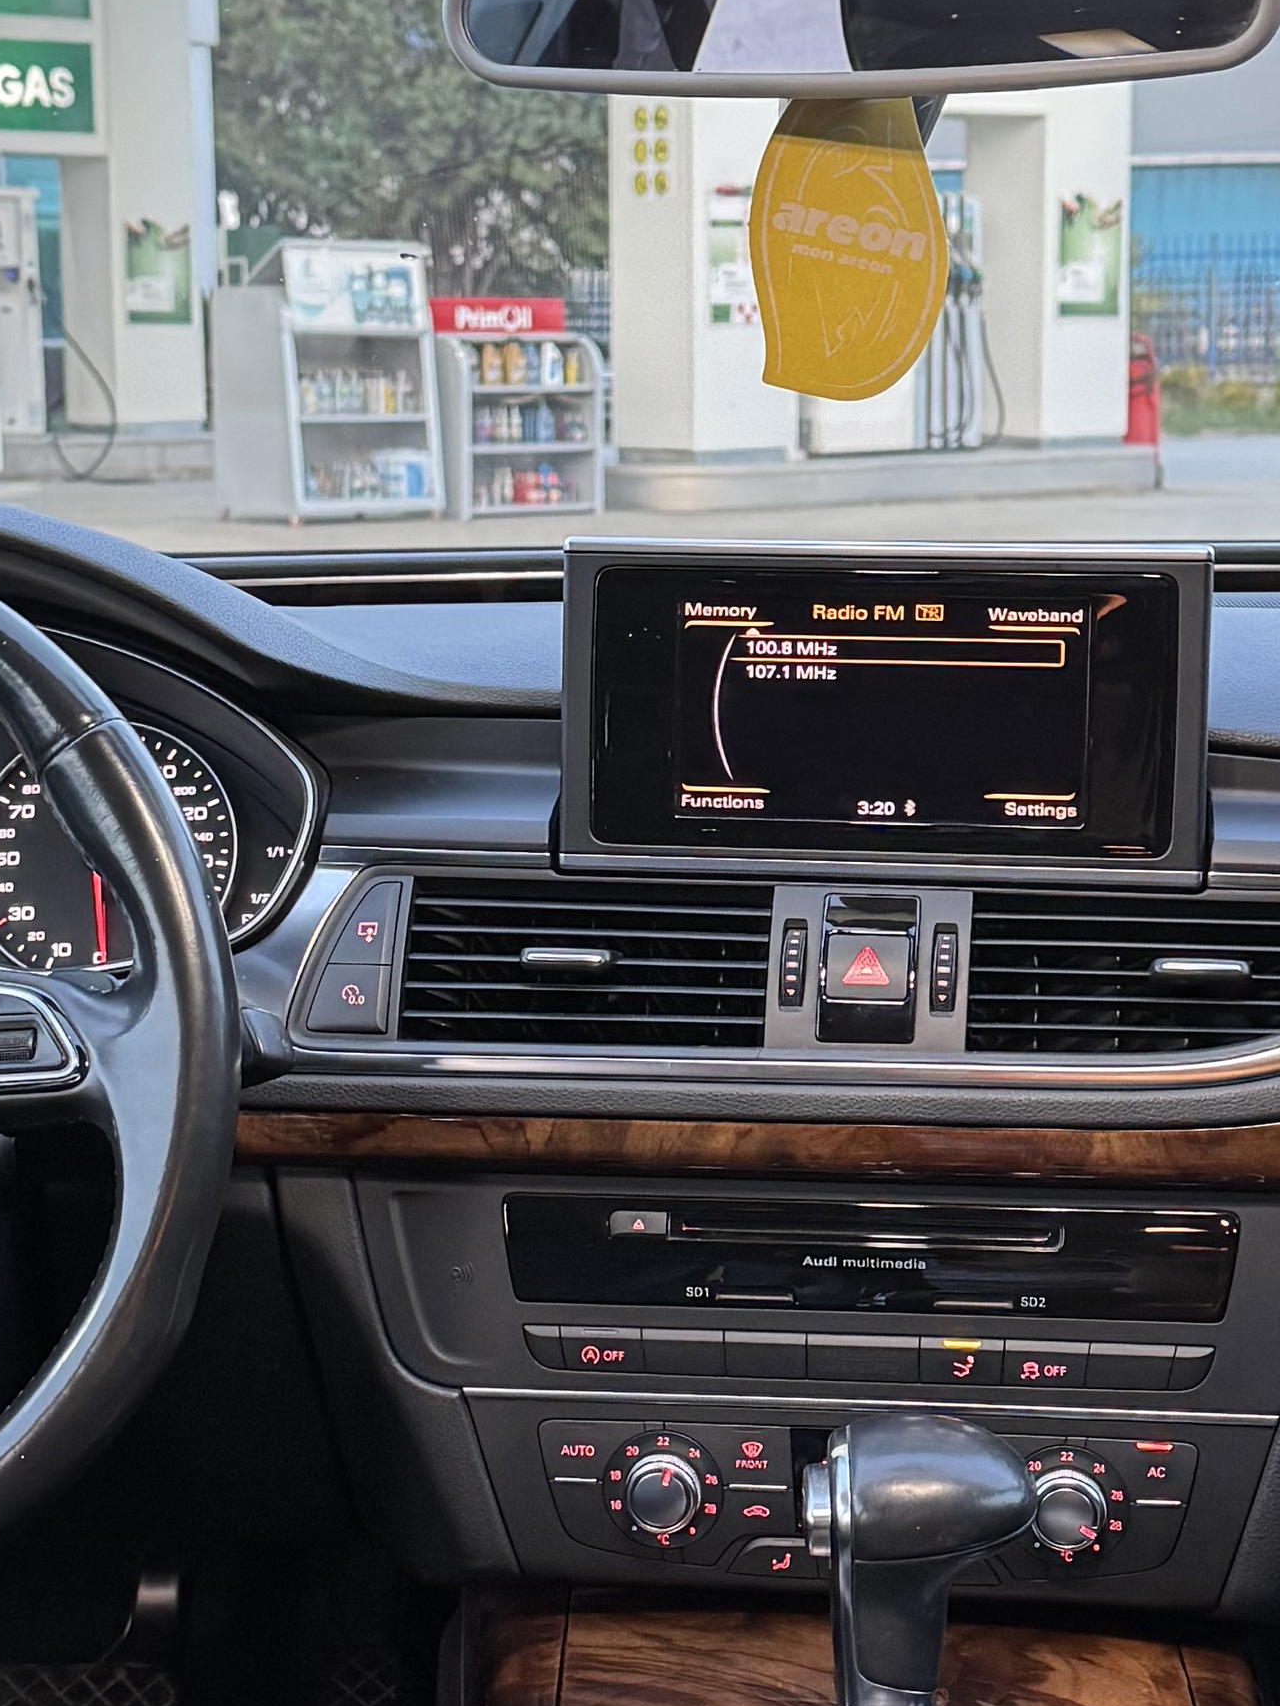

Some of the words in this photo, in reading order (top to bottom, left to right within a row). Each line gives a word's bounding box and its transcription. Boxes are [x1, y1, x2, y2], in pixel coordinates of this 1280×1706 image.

[772, 202, 927, 261] areon
[792, 244, 834, 262] mon
[838, 254, 893, 274] areon
[684, 602, 757, 620] Memory
[812, 604, 868, 621] Radio
[874, 605, 905, 621] FM
[987, 607, 1084, 623] Waveband
[746, 641, 792, 655] 100.8
[796, 642, 837, 656] MHz
[745, 664, 790, 679] 107.1
[795, 665, 837, 680] MHz
[681, 794, 765, 810] Functions
[856, 801, 896, 816] 3:20
[8, 804, 36, 820] 70
[1004, 801, 1078, 819] Settings
[266, 846, 285, 858] 1/1
[7, 905, 36, 921] 30
[26, 931, 46, 941] 20
[51, 942, 72, 957] 10
[802, 1256, 838, 1267] Audi
[842, 1257, 926, 1270] multimedia
[686, 1287, 710, 1297] SD1
[1021, 1297, 1046, 1308] SD2
[603, 1350, 625, 1362] OFF
[1043, 1365, 1067, 1377] OFF
[656, 1436, 670, 1446] 22
[560, 1444, 596, 1457] AUTO
[625, 1445, 639, 1455] 20
[1060, 1452, 1074, 1462] 22
[735, 1459, 768, 1470] FRONT
[1027, 1461, 1042, 1472] 20
[1093, 1463, 1106, 1474] 24
[1146, 1466, 1167, 1479] AC
